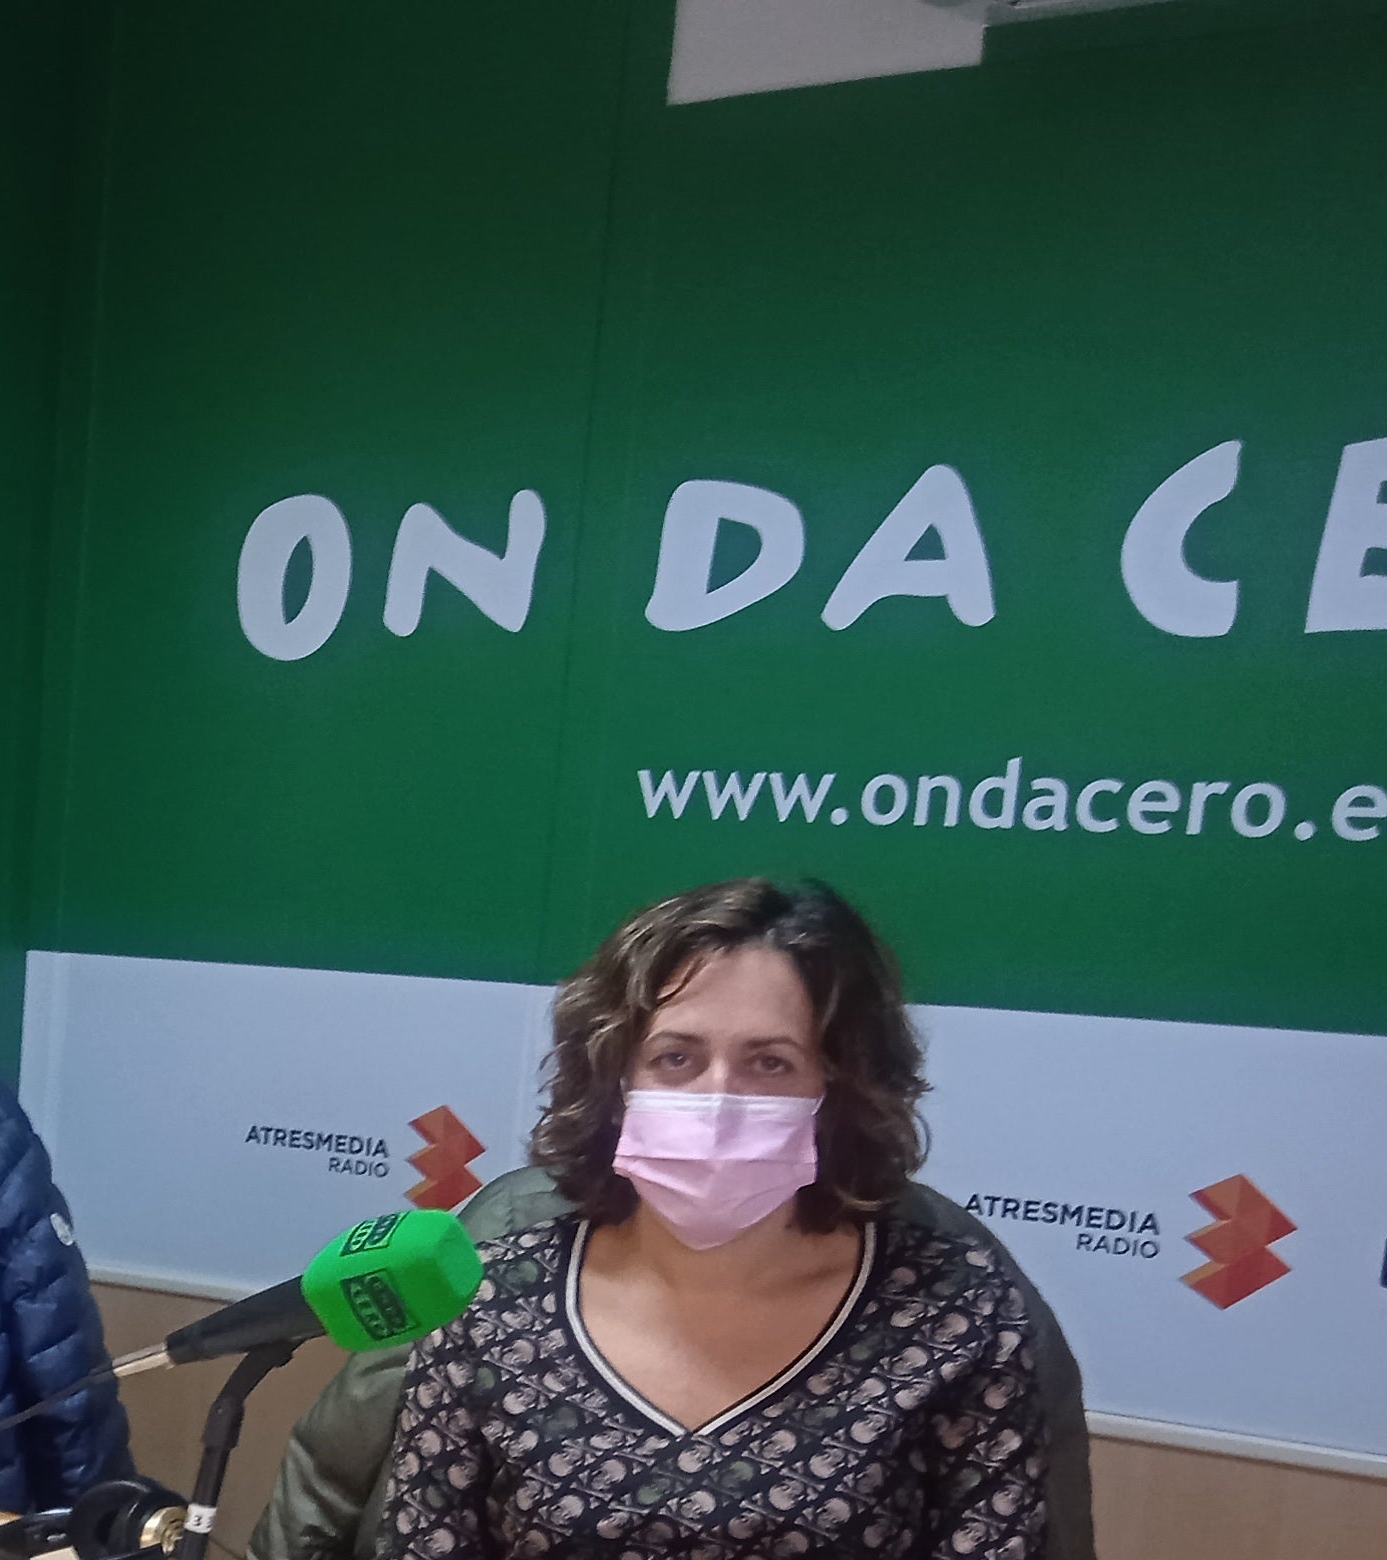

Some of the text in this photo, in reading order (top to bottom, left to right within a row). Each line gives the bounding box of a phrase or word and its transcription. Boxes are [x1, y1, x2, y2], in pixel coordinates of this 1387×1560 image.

[637, 756, 1387, 842] www.ondacero.e
[245, 1125, 390, 1159] ATRESMEDIA
[328, 1157, 390, 1178] RADIO
[965, 1193, 1161, 1236] ATRESMEDIA
[1077, 1233, 1160, 1259] RADIO
